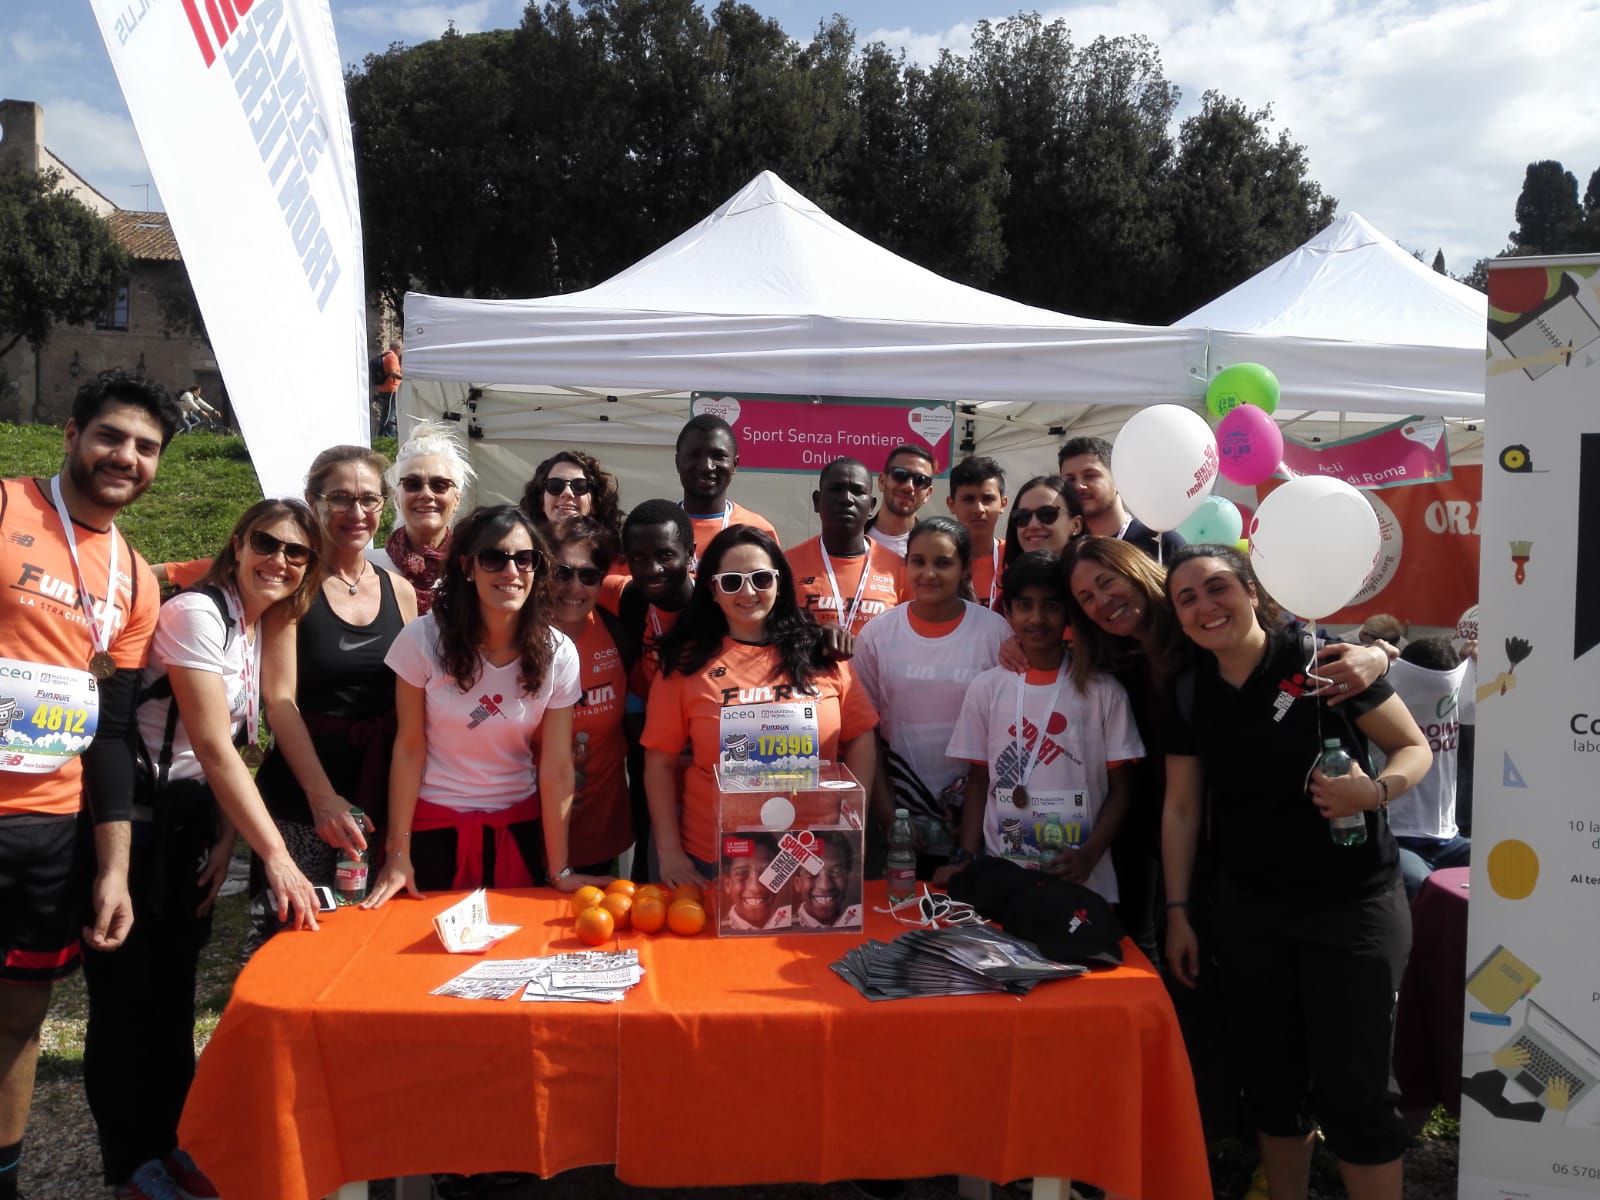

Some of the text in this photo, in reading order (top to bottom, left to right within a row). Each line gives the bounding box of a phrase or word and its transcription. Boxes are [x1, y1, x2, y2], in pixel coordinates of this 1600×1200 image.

[742, 426, 784, 444] Sport
[788, 428, 833, 444] Senza
[837, 430, 905, 447] Frontiere
[1347, 465, 1407, 484] di Roma
[19, 596, 35, 606] LA
[35, 689, 71, 702] FunRun
[31, 703, 88, 733] 4812
[724, 710, 755, 720] acea
[757, 734, 813, 756] 17396
[1568, 820, 1585, 832] 10
[781, 835, 812, 864] SPORT
[770, 850, 792, 873] SENZA
[769, 857, 800, 892] FRONTIERE
[1570, 874, 1600, 885] Al te
[1552, 1162, 1569, 1175] 06
